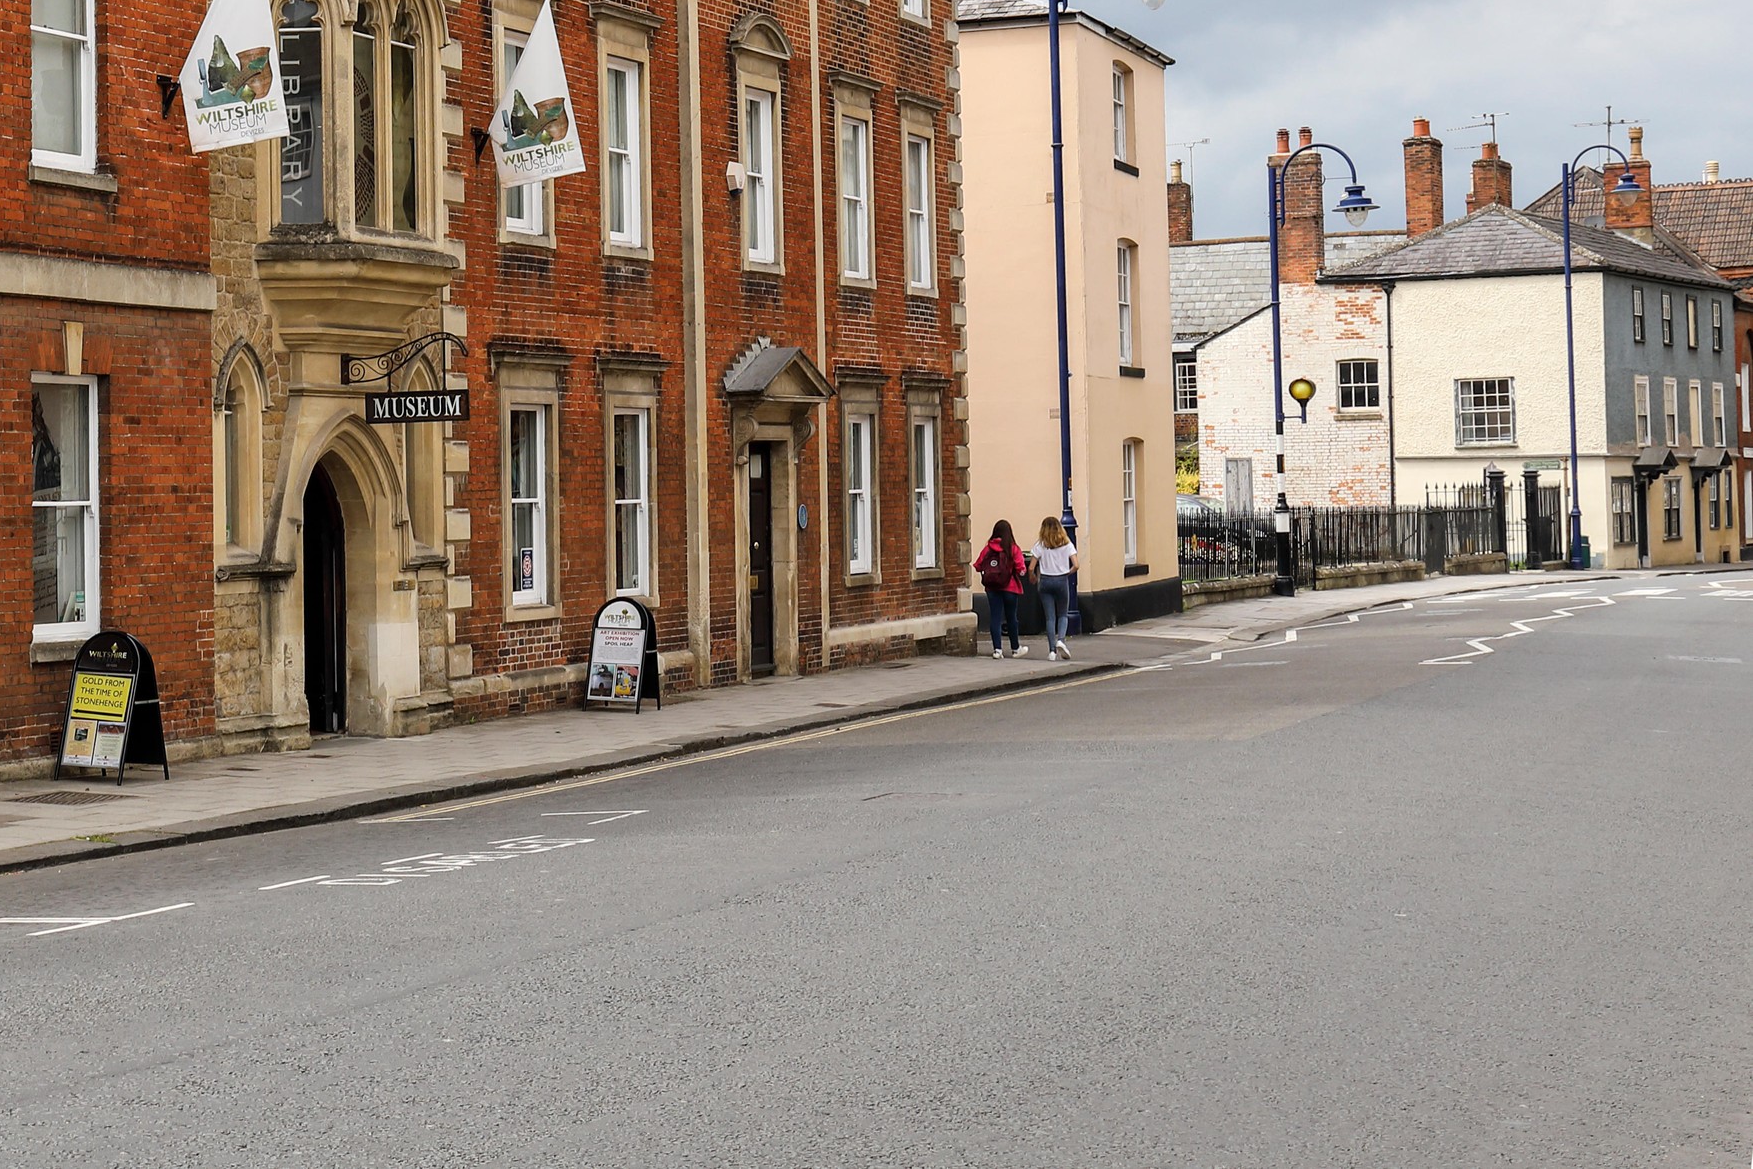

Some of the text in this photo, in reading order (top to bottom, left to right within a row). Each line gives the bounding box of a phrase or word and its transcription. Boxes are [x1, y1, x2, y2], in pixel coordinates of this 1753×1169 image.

[195, 99, 278, 126] WILTSHIRE
[280, 34, 303, 207] LIBRARY
[209, 113, 267, 135] MUSEUM
[240, 127, 265, 138] DEVIZES
[502, 140, 575, 166] WILTSHIRE
[514, 153, 566, 174] MUSEUM
[373, 394, 462, 419] MUSEUM
[89, 649, 128, 660] WILTSHIRE
[81, 686, 123, 698] THE TIME OF
[82, 676, 125, 688] GOLD FROM
[75, 696, 124, 709] STONEHENGE
[316, 838, 596, 886] DISABLED
